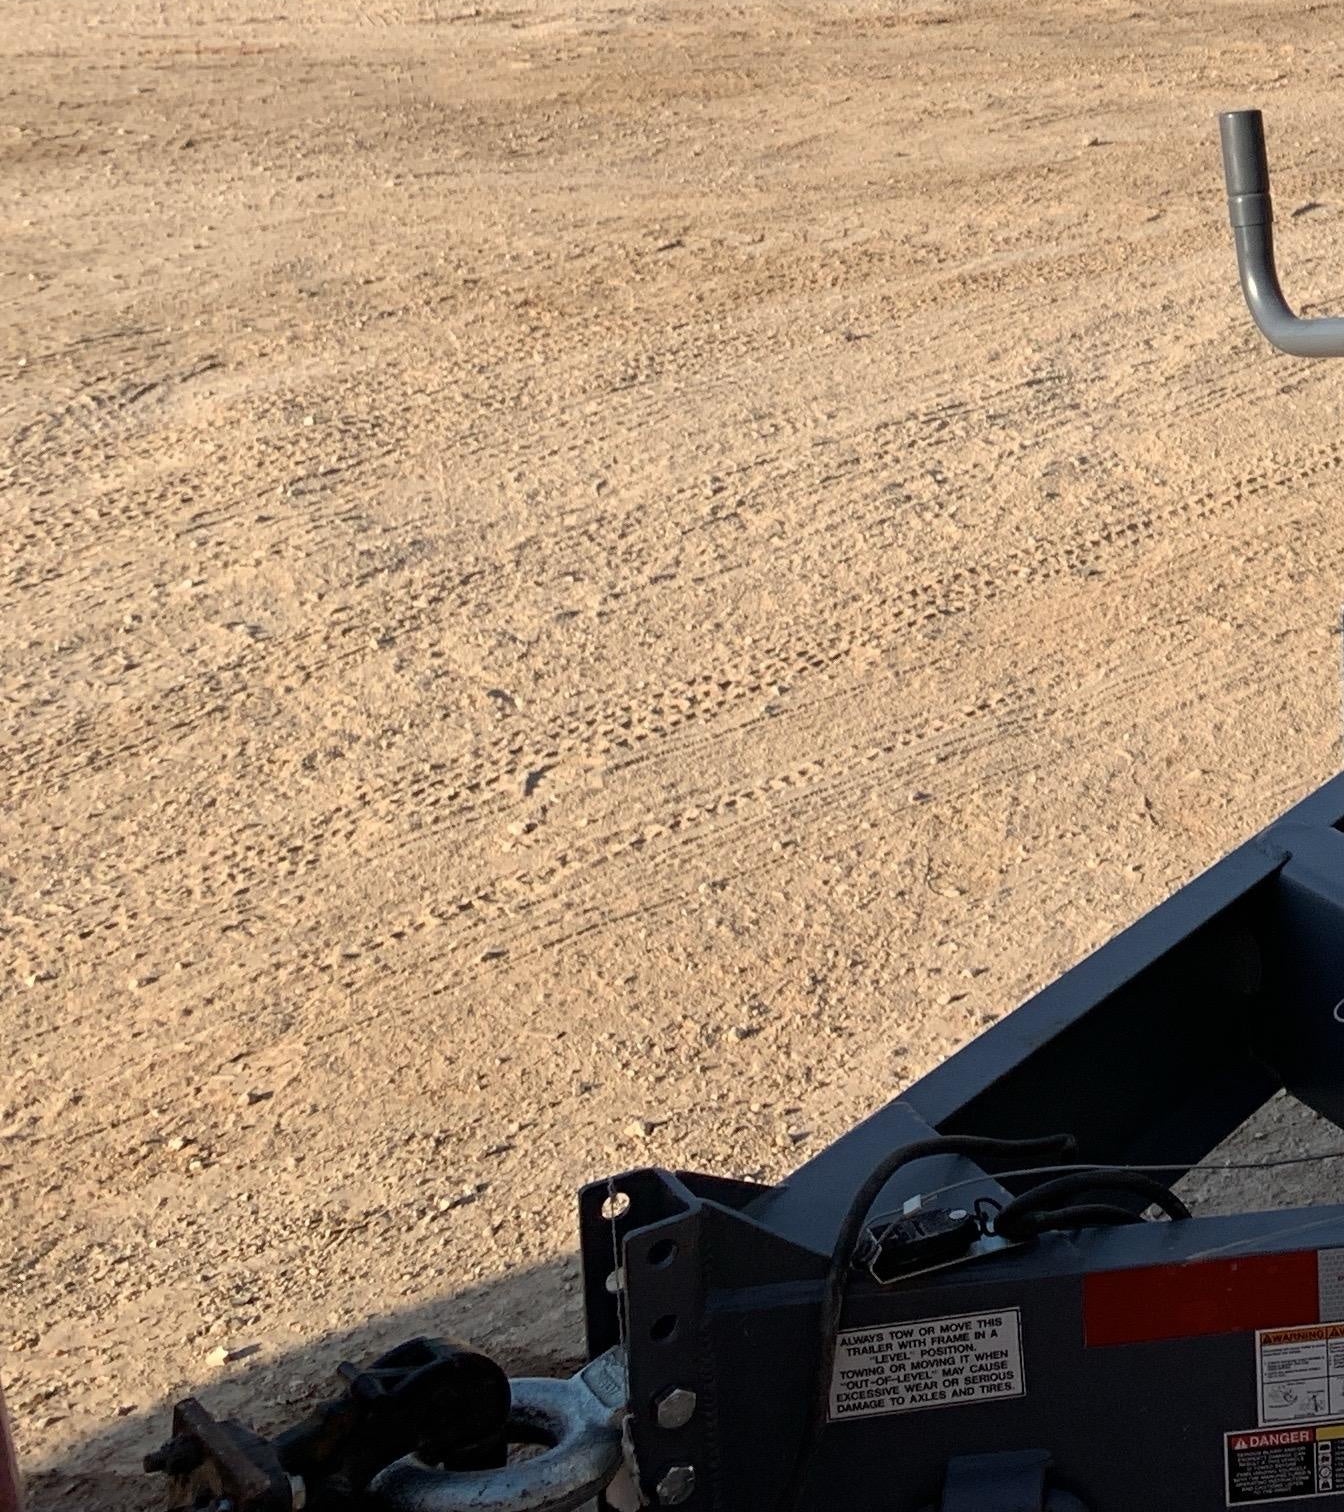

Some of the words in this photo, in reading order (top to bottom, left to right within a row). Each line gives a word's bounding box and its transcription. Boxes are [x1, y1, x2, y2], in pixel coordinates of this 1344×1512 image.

[841, 1333, 884, 1347] ALWAYS
[890, 1330, 914, 1341] TOW
[919, 1327, 935, 1336] OR
[940, 1322, 971, 1333] MOVE
[977, 1318, 1002, 1327] THIS
[848, 1343, 893, 1356] TRAILER
[899, 1339, 927, 1350] WITH
[931, 1333, 969, 1345] FRAME
[974, 1332, 985, 1340] IN
[991, 1330, 998, 1338] A
[1270, 1329, 1324, 1343] WARNING
[921, 1344, 976, 1357] POSITION.
[841, 1367, 884, 1380] TOWING
[890, 1363, 906, 1372] OR
[911, 1357, 955, 1369] MOVING
[975, 1351, 1008, 1361] WHEN
[942, 1368, 964, 1377] MAY
[970, 1361, 1007, 1372] CAUSE
[837, 1386, 899, 1402] EXCESSIVE
[904, 1381, 938, 1393] WEAR
[943, 1377, 959, 1387] OR
[965, 1372, 1013, 1385] SERIOUS
[838, 1398, 885, 1413] DAMAGE
[890, 1397, 905, 1405] TO
[910, 1392, 946, 1404] AXLES
[952, 1387, 974, 1397] AND
[981, 1382, 1014, 1393] TIRES.
[1250, 1431, 1309, 1447] DANGER
